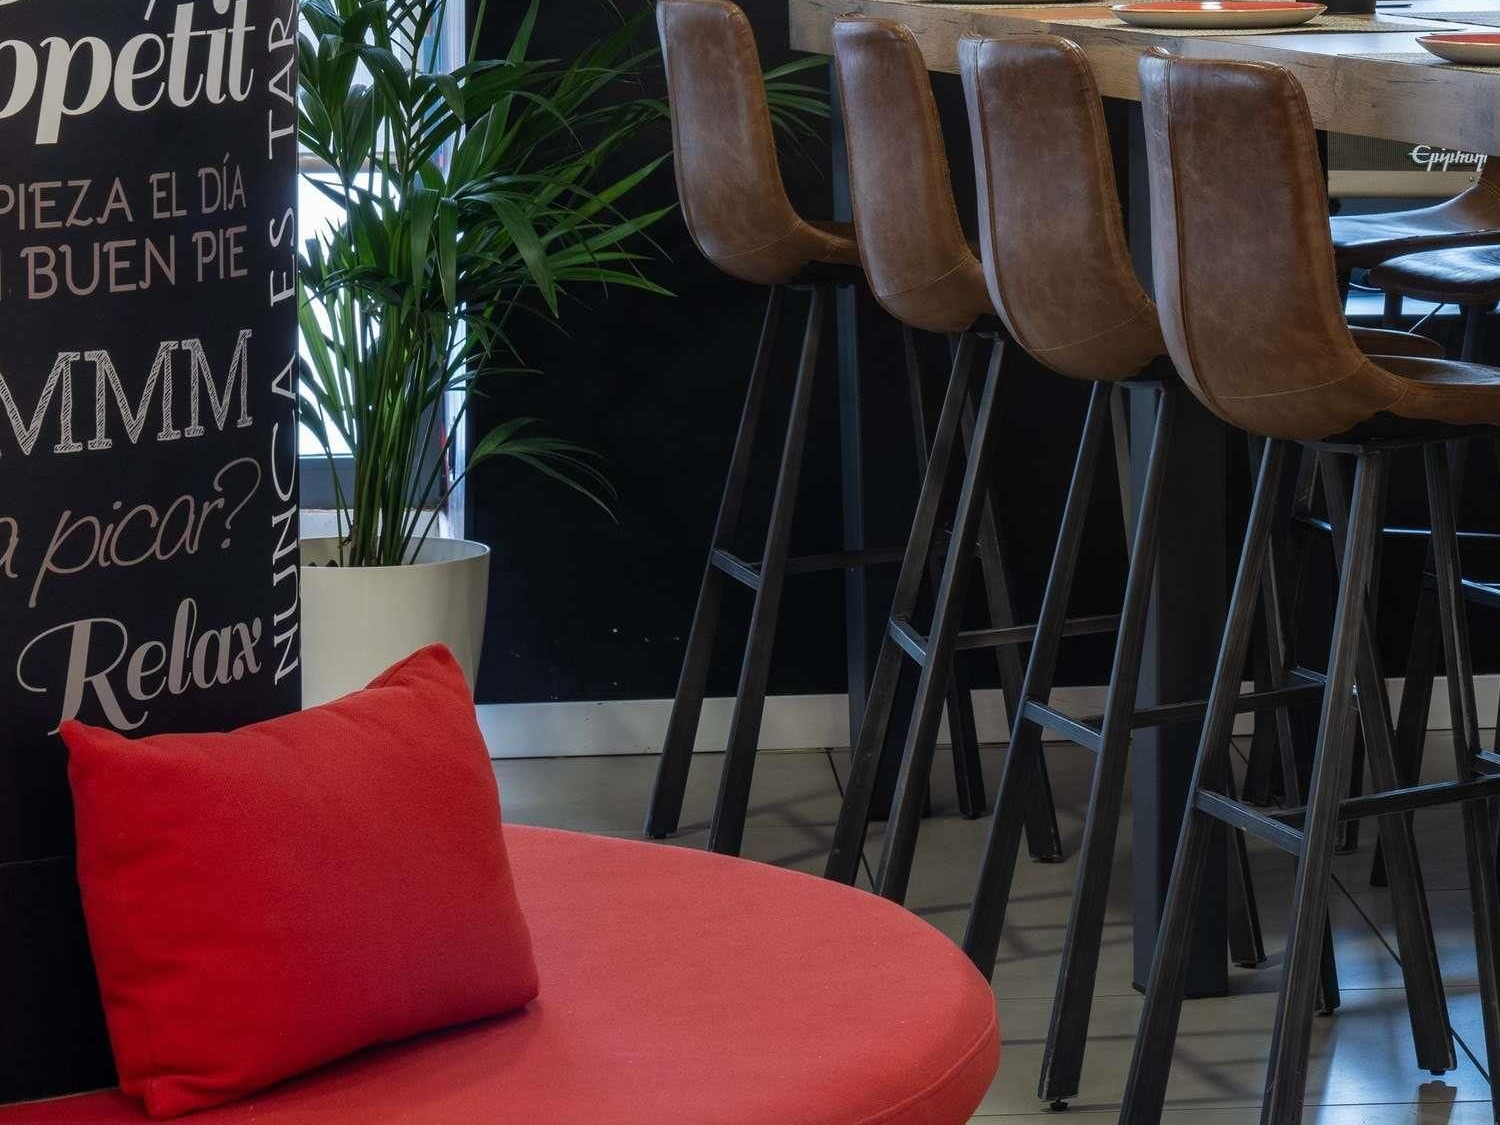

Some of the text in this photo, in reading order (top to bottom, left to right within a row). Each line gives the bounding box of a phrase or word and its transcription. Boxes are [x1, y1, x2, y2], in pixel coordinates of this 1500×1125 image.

[149, 172, 187, 219] EL
[198, 152, 248, 215] DÍA
[20, 226, 248, 300] BUEN PIE
[269, 207, 297, 306] ES
[29, 457, 262, 608] picar?
[271, 350, 299, 686] NUNCA
[17, 597, 263, 735] Relax
